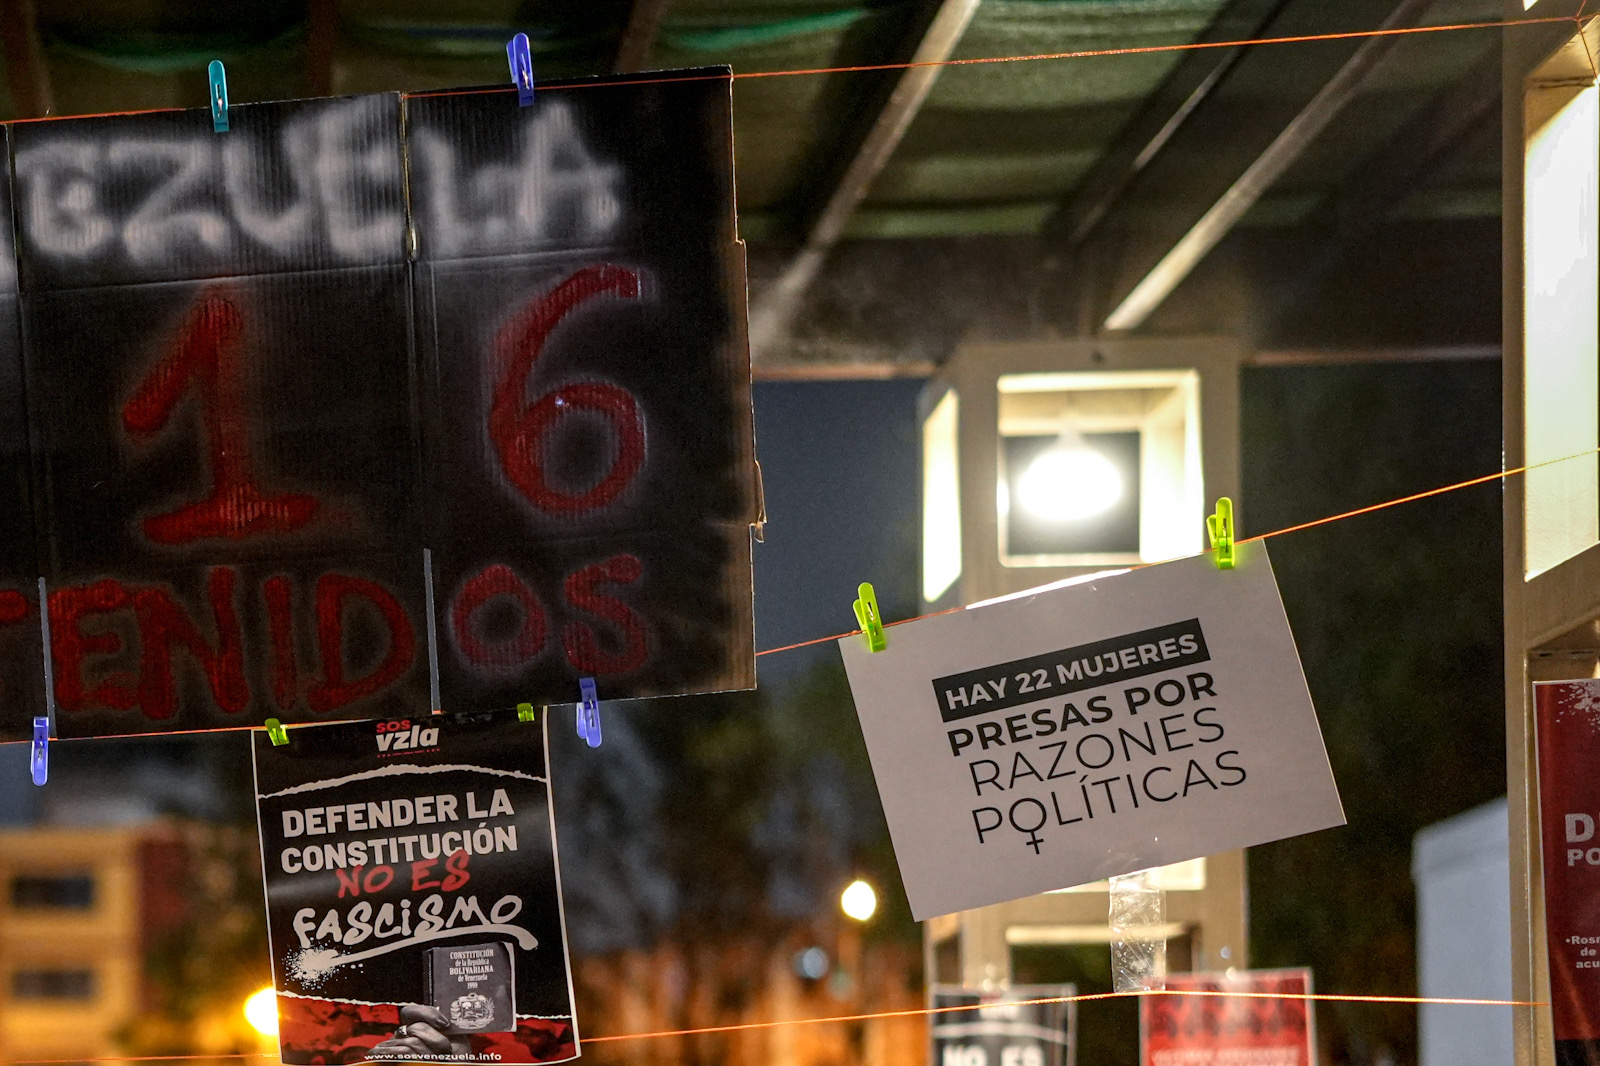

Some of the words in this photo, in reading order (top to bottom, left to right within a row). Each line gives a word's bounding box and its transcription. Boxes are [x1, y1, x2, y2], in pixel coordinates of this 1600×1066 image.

[945, 677, 1006, 711] HAY
[1017, 669, 1052, 695] 22
[1056, 633, 1199, 685] MUJERES
[376, 725, 439, 751] vzla
[377, 720, 411, 733] SOS
[947, 696, 1112, 757] PRESAS
[1124, 672, 1218, 715] POR
[968, 707, 1225, 797] RAZONES
[282, 794, 459, 837] DEFENDER
[467, 789, 515, 819] LA
[971, 750, 1247, 855] POLÍTICAS
[281, 823, 518, 873] CONSTITUCIÓN
[1567, 848, 1600, 867] PO
[337, 864, 394, 898] NO
[412, 849, 471, 892] ES
[364, 1051, 502, 1062] www.sosvenezuela.info
